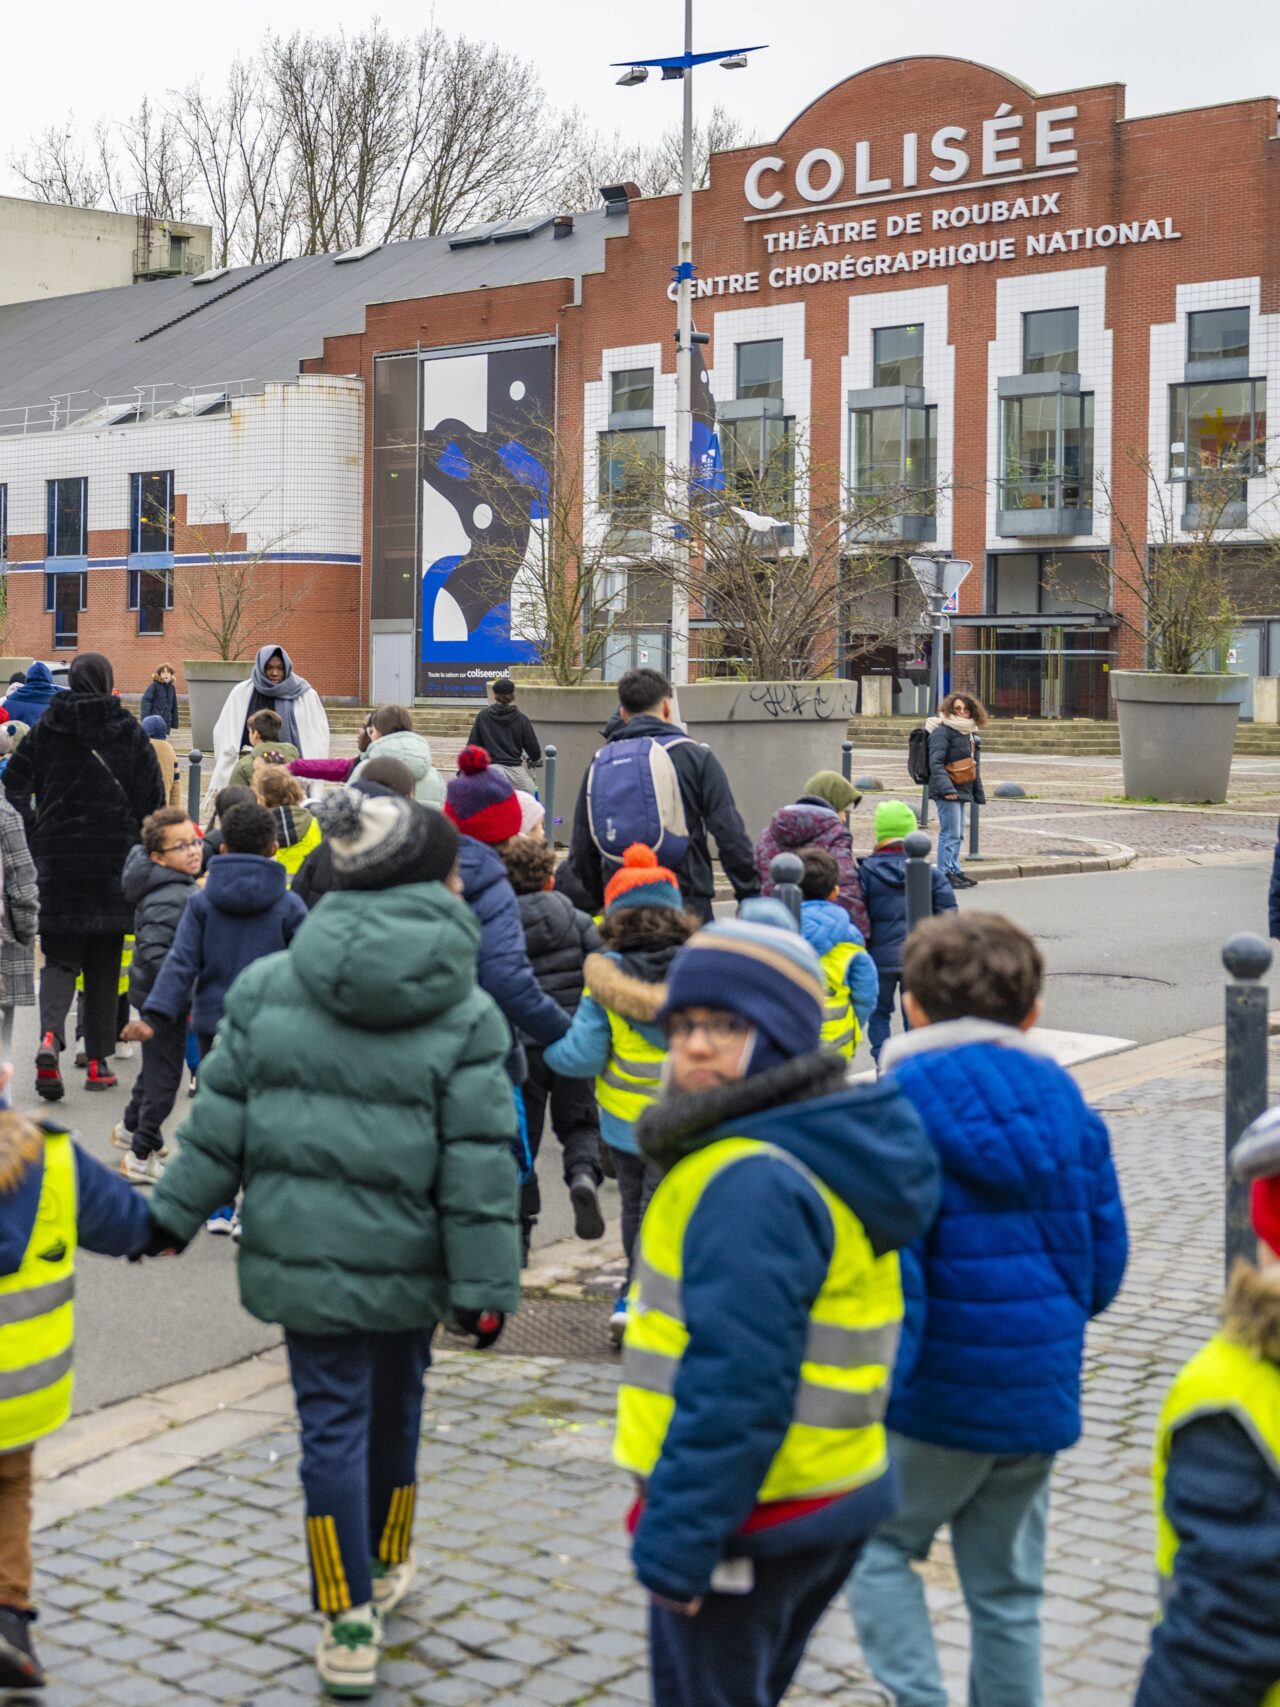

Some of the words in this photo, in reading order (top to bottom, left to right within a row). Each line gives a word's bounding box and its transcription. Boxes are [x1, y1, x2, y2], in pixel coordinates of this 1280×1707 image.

[744, 103, 1078, 211] COLISÉE
[763, 220, 877, 253] THÉÂTRE
[887, 213, 922, 237] DE
[932, 192, 1061, 230] ROUBAIX
[769, 238, 1016, 288] CHORÉGRAPHIQUE
[1027, 217, 1181, 256] NATIONAL
